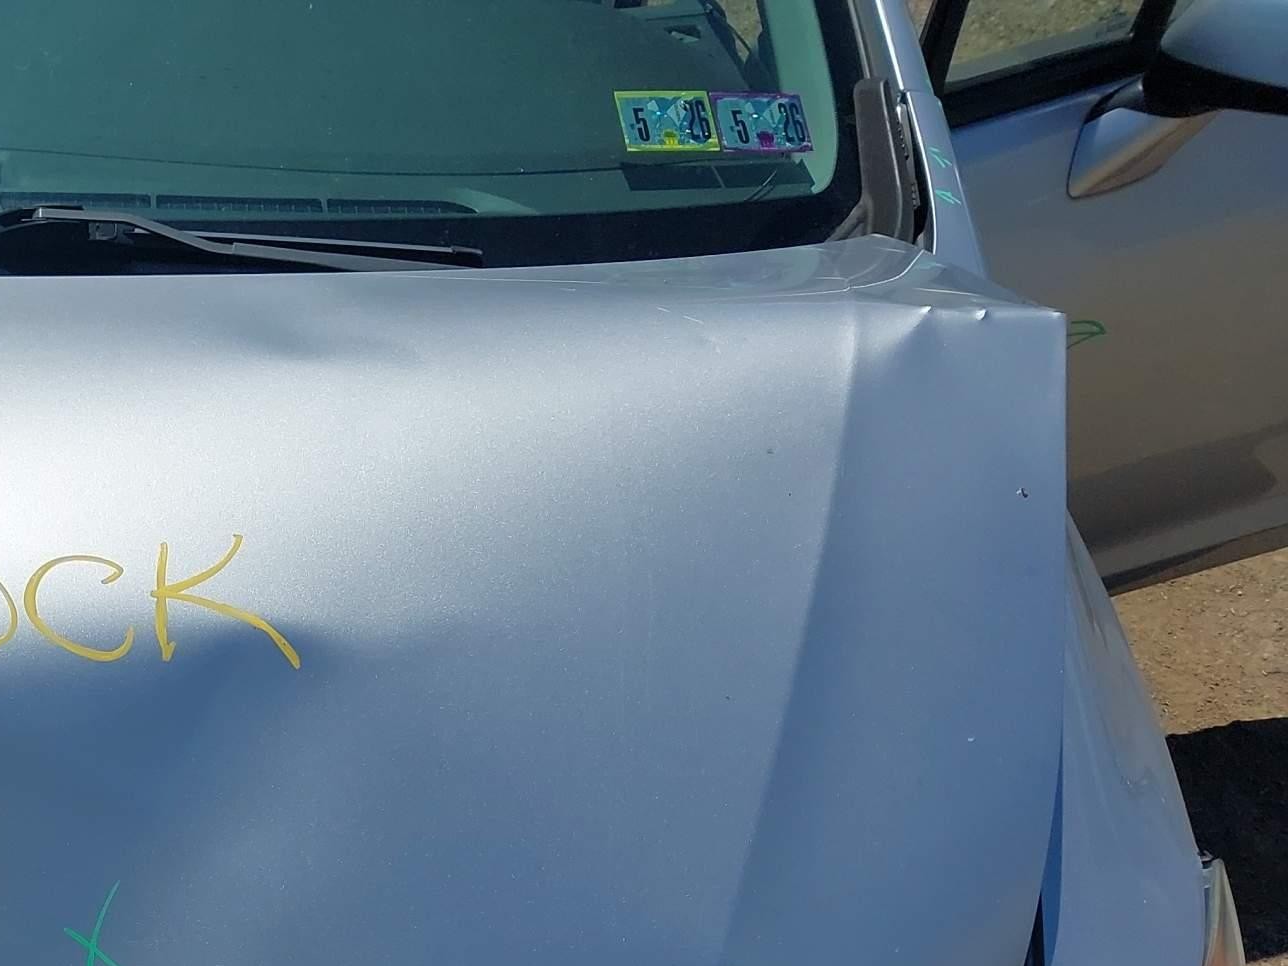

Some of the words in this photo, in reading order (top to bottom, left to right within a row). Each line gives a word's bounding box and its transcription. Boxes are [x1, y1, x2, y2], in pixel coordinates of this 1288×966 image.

[632, 107, 650, 142] 5
[680, 100, 712, 142] 26
[731, 109, 750, 144] 5
[777, 102, 807, 143] 26
